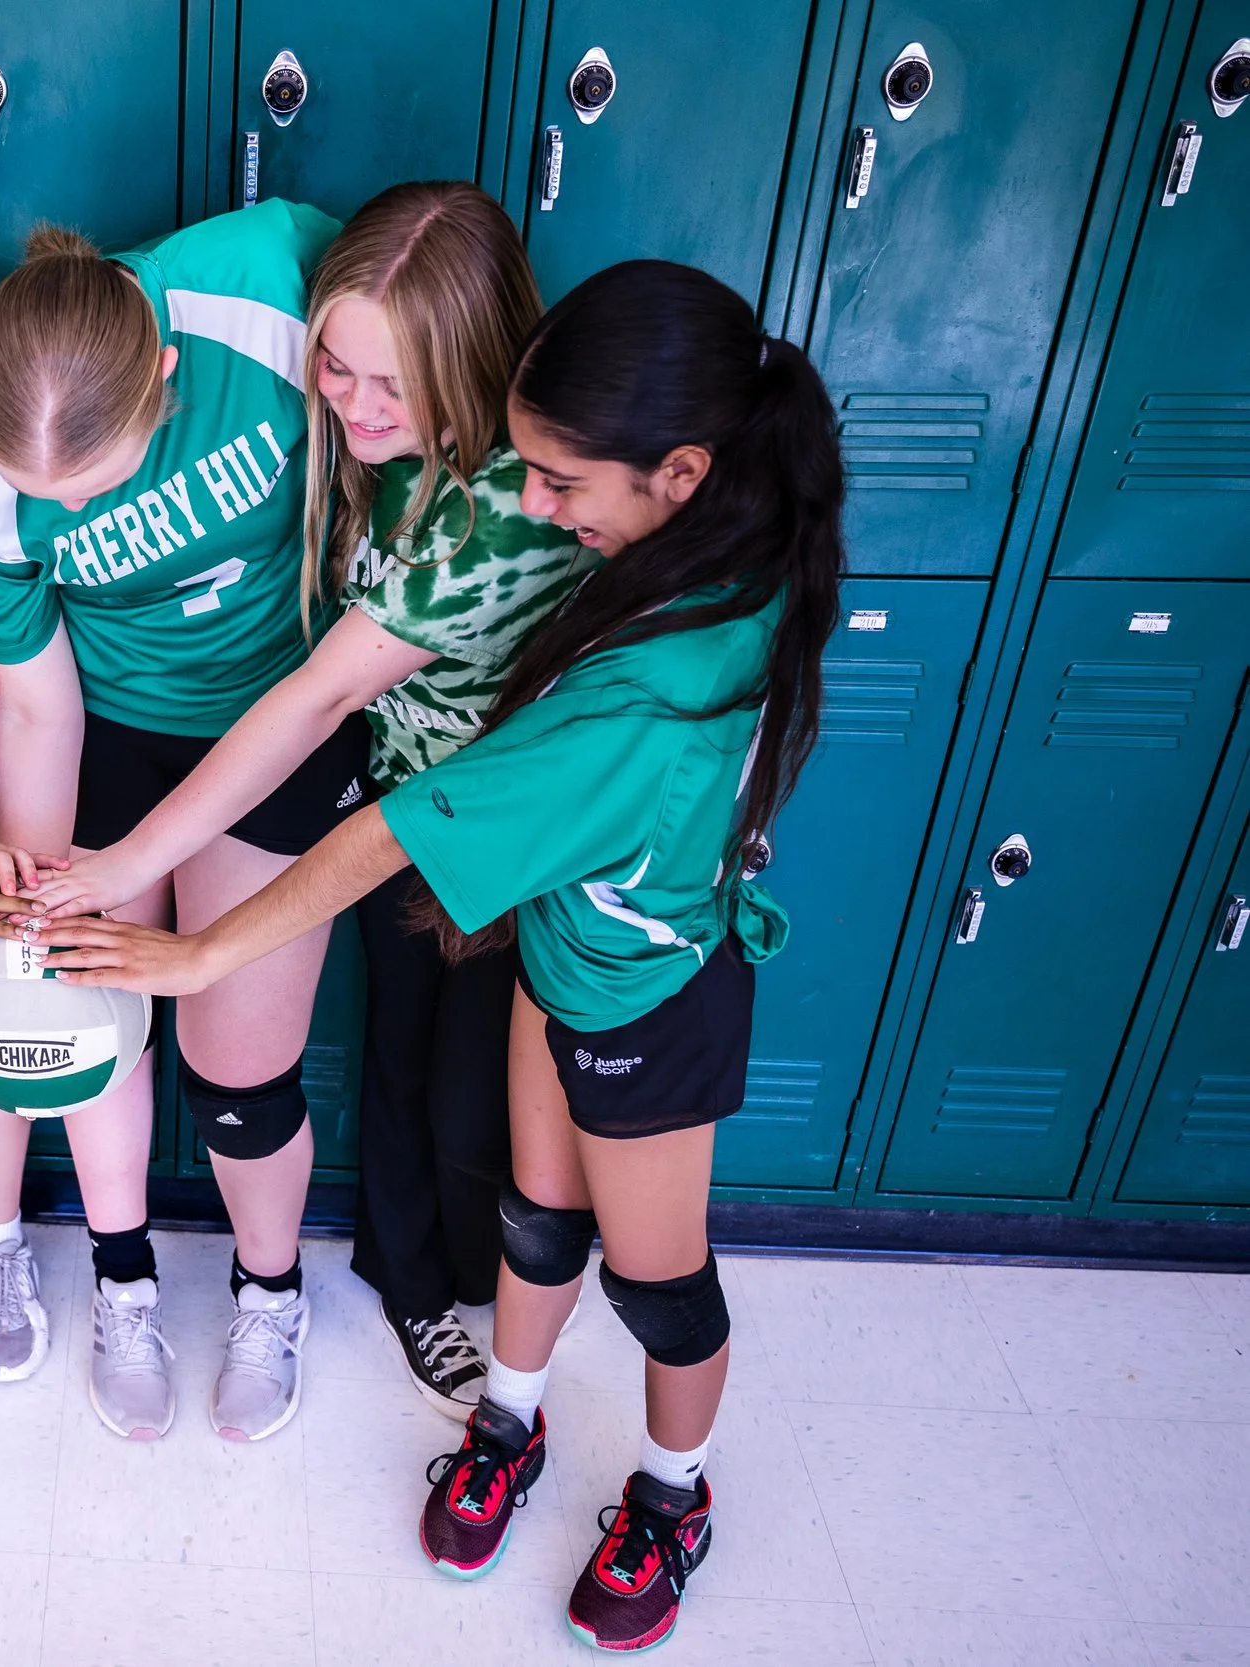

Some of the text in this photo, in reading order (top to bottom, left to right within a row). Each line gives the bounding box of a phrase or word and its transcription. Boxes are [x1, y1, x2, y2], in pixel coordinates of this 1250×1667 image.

[247, 152, 256, 194] PENCO
[53, 420, 289, 587] CHERRY HILL
[173, 556, 248, 618] 7
[337, 790, 363, 808] adidas
[594, 1057, 642, 1068] Justice
[595, 1065, 631, 1075] Sport
